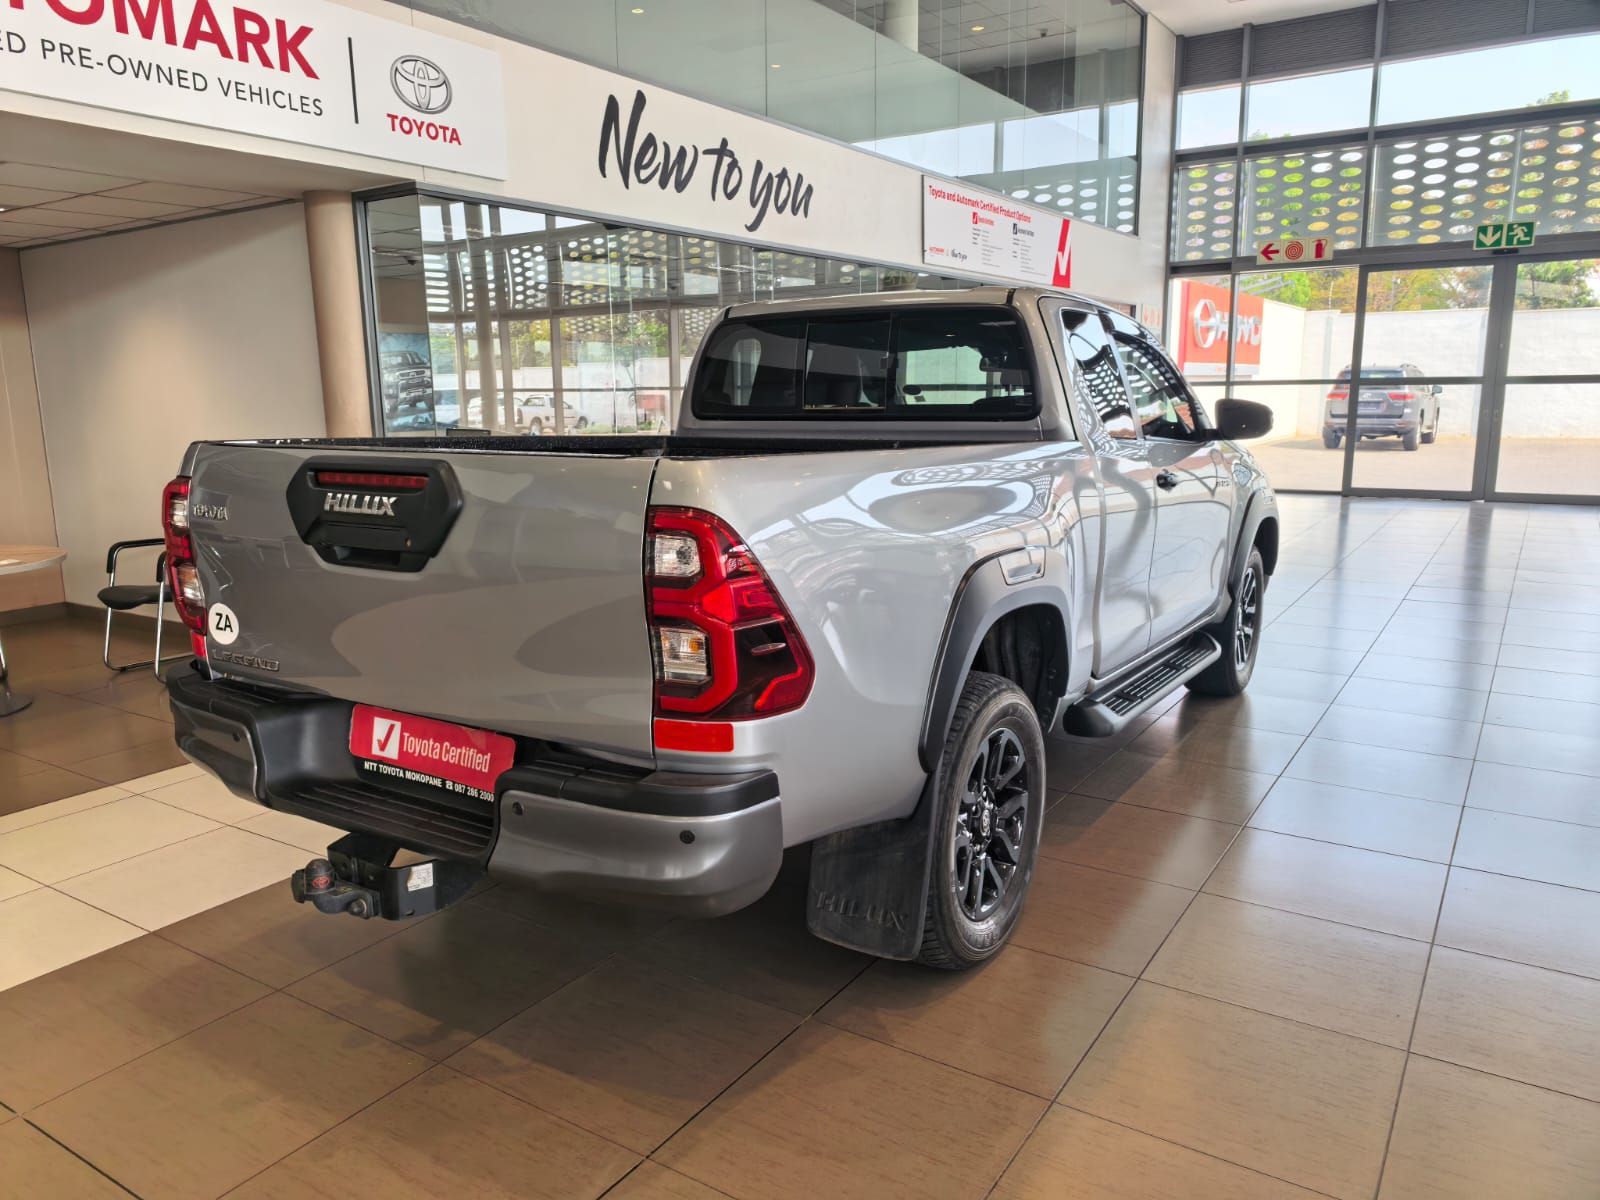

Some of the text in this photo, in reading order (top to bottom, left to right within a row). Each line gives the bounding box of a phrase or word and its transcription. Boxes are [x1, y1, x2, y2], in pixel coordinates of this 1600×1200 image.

[0, 30, 323, 117] D PRE-OWNED VEHICLES
[386, 113, 462, 146] TOYOTA
[598, 89, 813, 232] New to you
[929, 185, 1031, 223] Toyota and Automark Certified Product Options
[1215, 311, 1262, 346] HNO
[193, 504, 228, 521] TOYOTA
[324, 492, 398, 516] HILUX
[215, 612, 234, 633] ZA
[212, 650, 280, 672] LEGEND
[403, 732, 491, 773] Toyota Certified
[364, 760, 378, 772] NTT
[378, 764, 405, 778] TOYOTA
[405, 770, 443, 788] MOKOPANE
[454, 783, 466, 795] 087
[816, 891, 906, 934] HILUX
